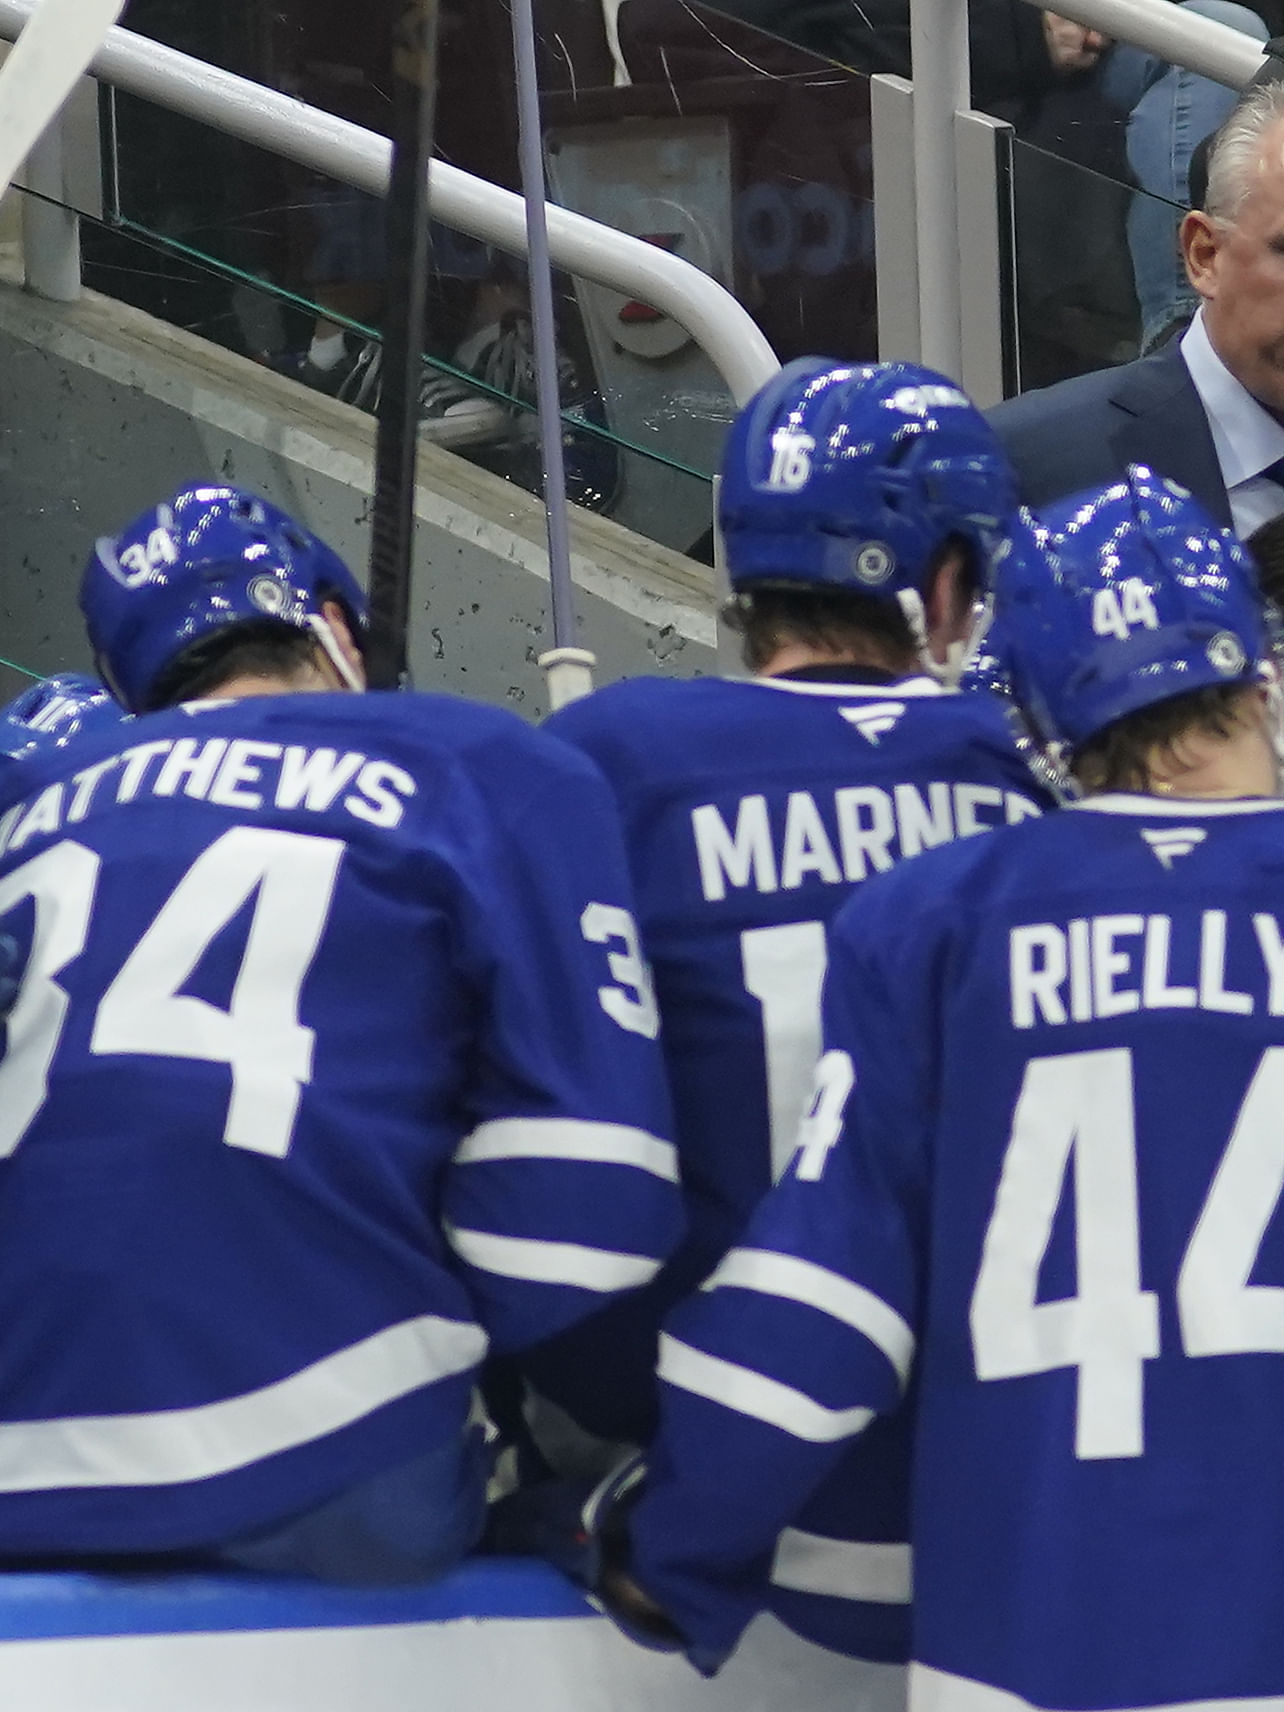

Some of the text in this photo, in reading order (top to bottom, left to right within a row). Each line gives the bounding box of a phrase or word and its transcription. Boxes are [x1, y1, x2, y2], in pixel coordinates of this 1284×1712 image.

[772, 429, 816, 488] 16
[120, 527, 178, 588] 34
[1092, 577, 1160, 640] 44
